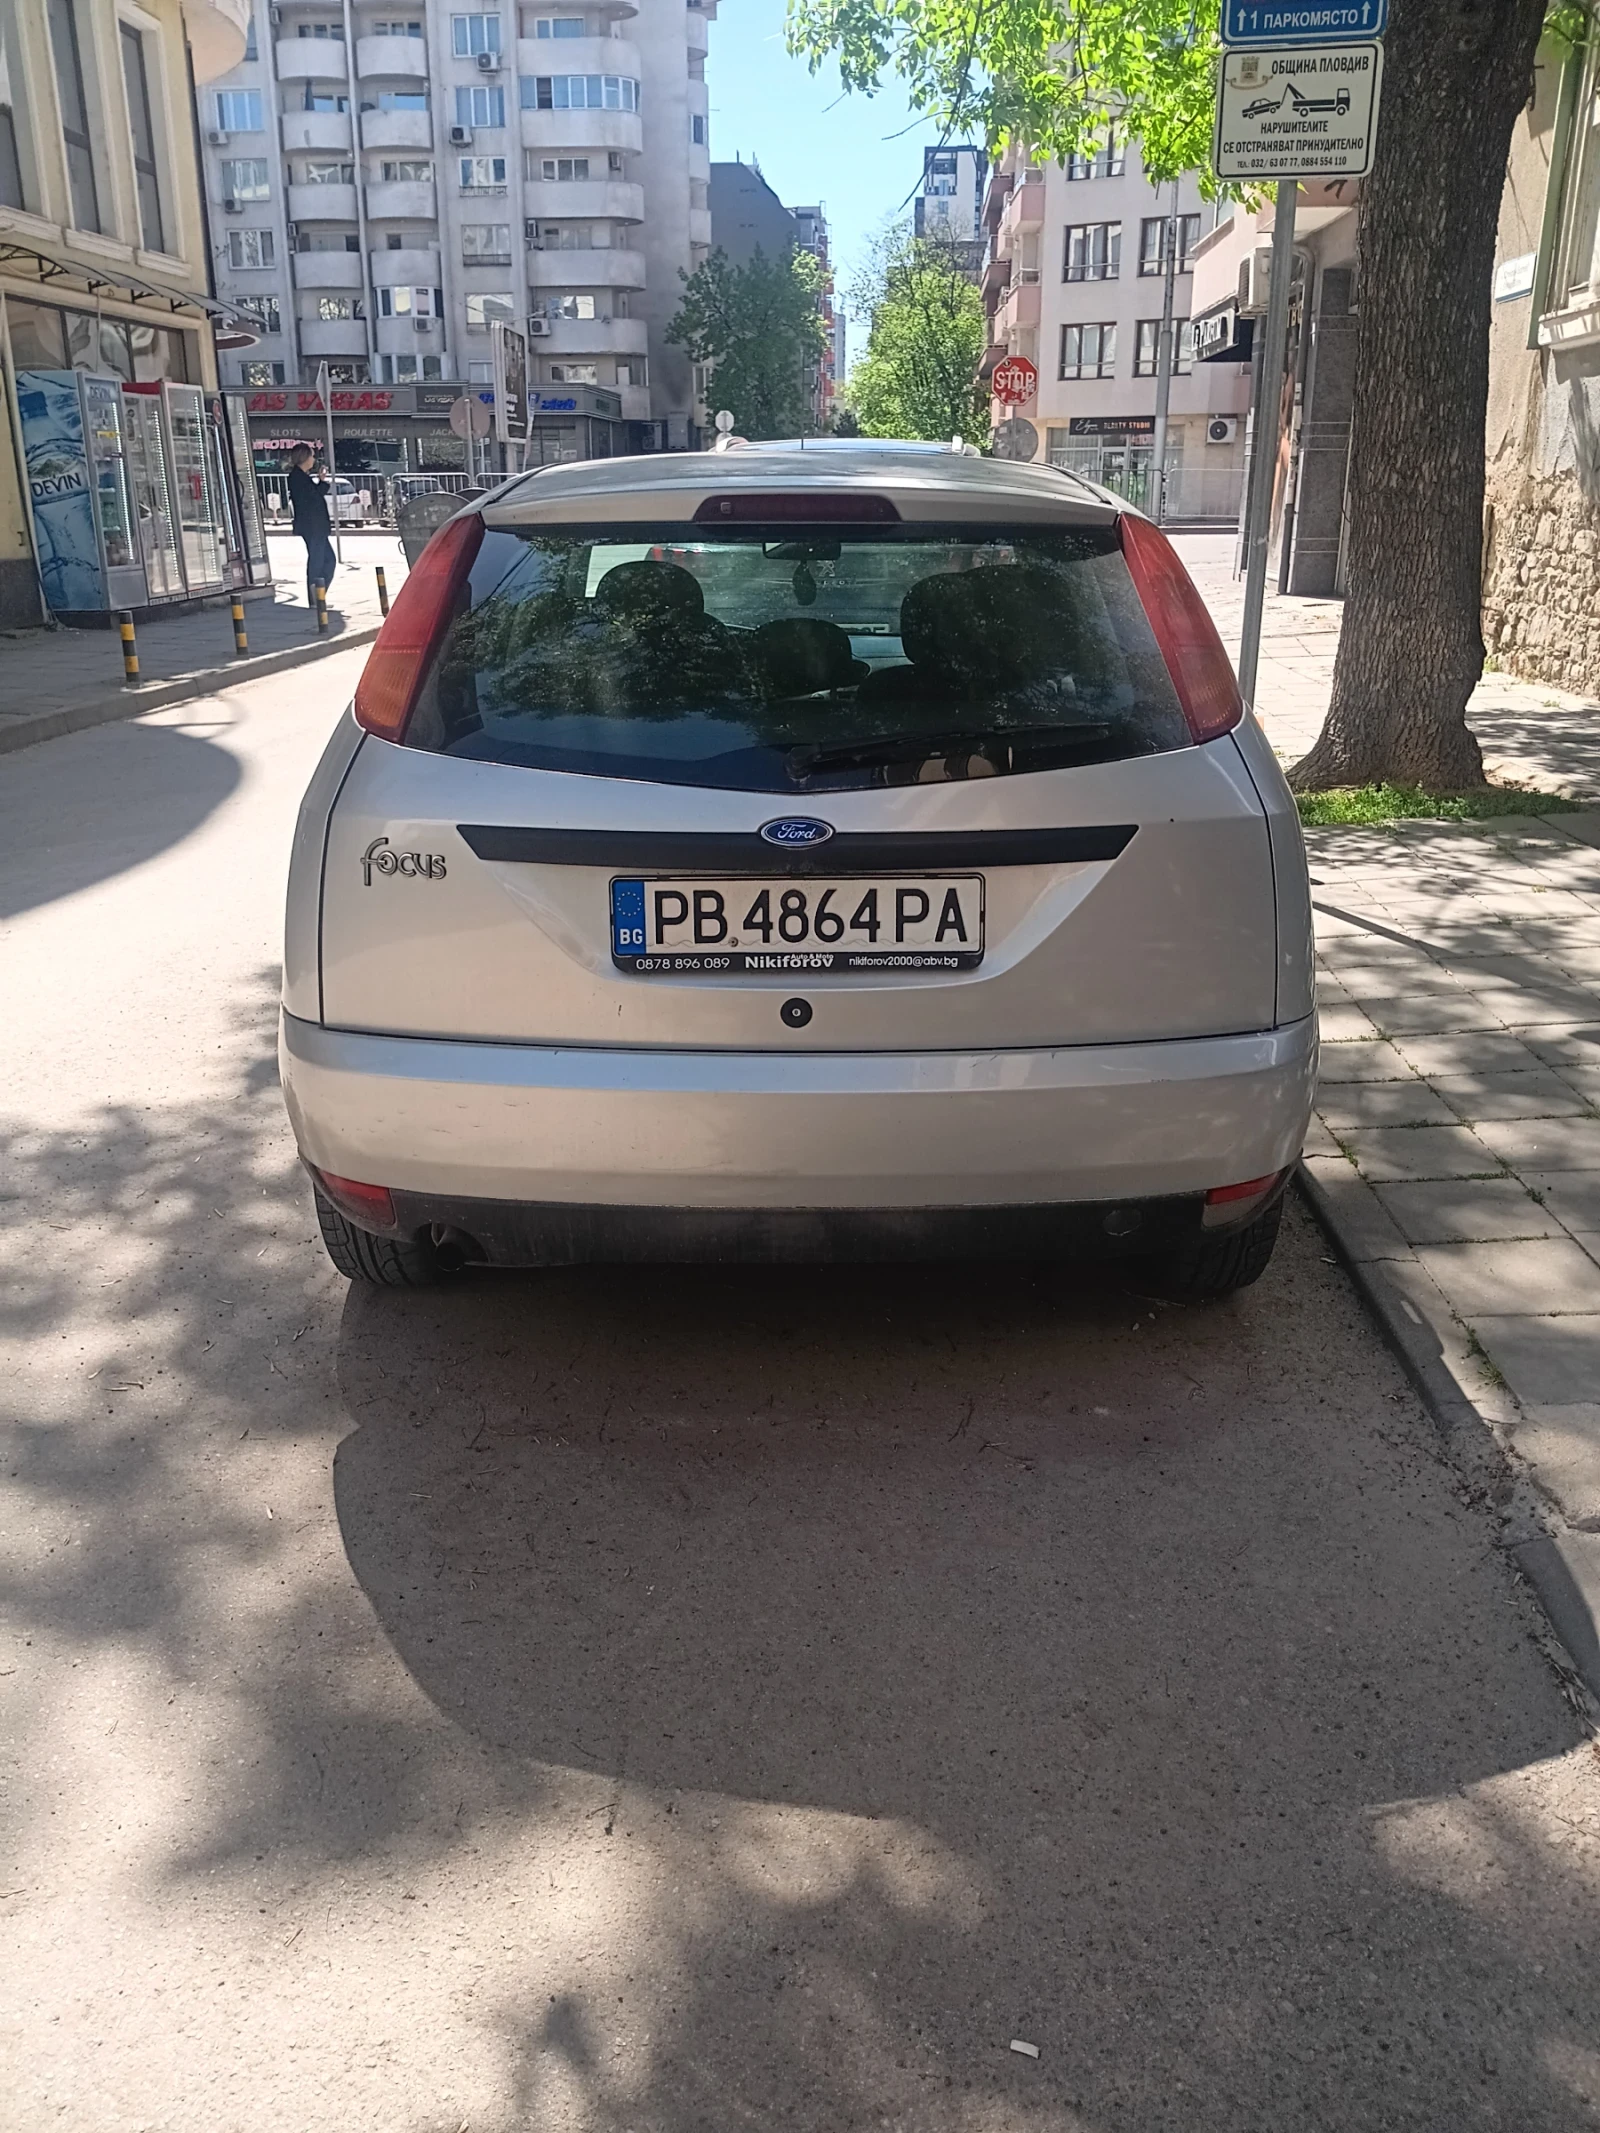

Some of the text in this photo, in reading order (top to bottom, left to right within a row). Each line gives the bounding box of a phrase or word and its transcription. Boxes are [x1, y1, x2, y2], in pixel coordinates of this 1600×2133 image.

[1250, 9, 1358, 29] 1 ПАРКОМЯСТО
[1271, 56, 1369, 75] ОБЩИНА ПЛОВДИВ
[1260, 120, 1329, 134] НАРУШИТЕЛИТЕ
[1223, 137, 1364, 153] СЕ ОТСТРАНЯВАТ ПРИНУДИТЕЛНО
[1269, 158, 1278, 167] 63
[1279, 157, 1288, 167] 07
[1300, 157, 1319, 167] 0884
[1319, 156, 1333, 166] 554
[1334, 155, 1347, 166] 110
[995, 371, 1035, 391] STOP
[297, 391, 395, 411] VEGAS
[270, 428, 457, 437] SLOTS ROULETTE JACK
[31, 471, 82, 499] DEVIN
[777, 823, 817, 840] Ford
[654, 887, 968, 945] PB 4864 PA
[619, 928, 643, 945] BG
[636, 957, 730, 970] 0878 896 089
[744, 955, 834, 969] Nikiforov
[849, 955, 959, 968] nikiforov2000@abv.bg
